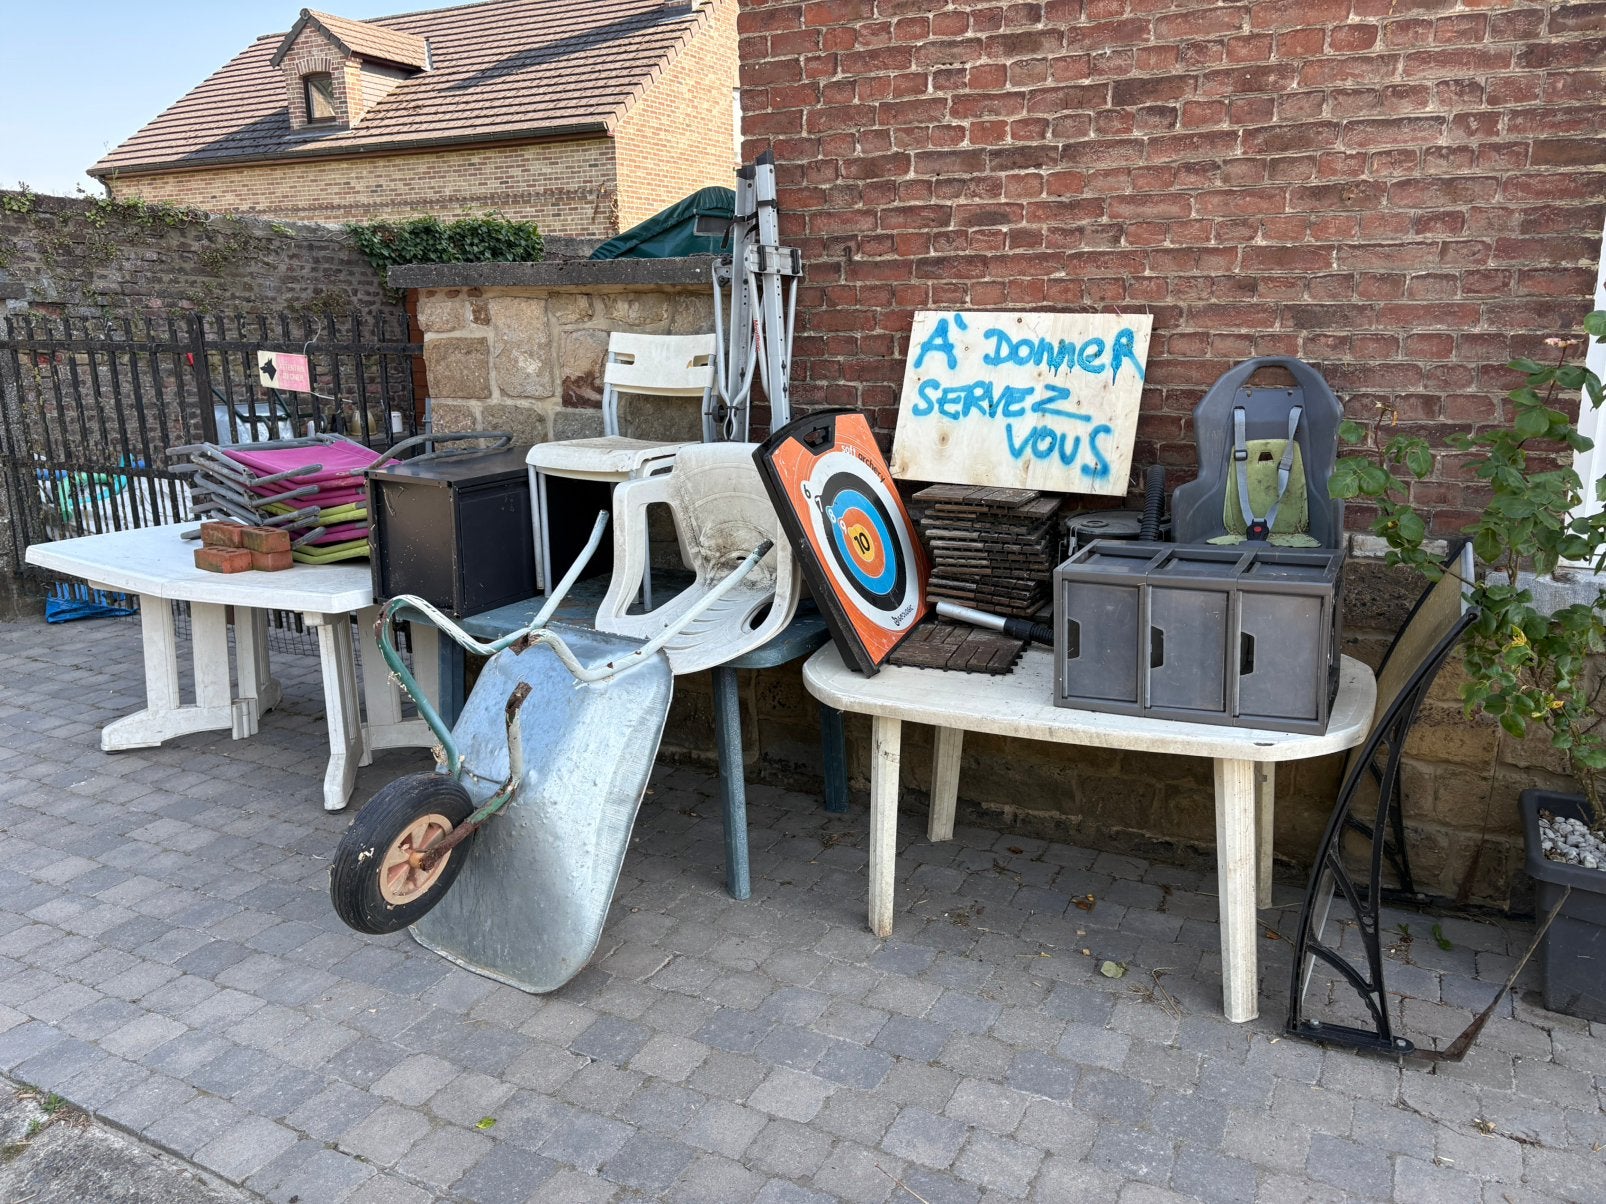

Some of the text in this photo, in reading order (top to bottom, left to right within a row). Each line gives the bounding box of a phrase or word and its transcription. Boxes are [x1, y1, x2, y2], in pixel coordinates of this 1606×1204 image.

[911, 378, 1092, 423] SERVEZ
[841, 443, 886, 483] soft archery
[1005, 423, 1112, 478] VOUS
[803, 483, 871, 555] 6 7 8 9 10
